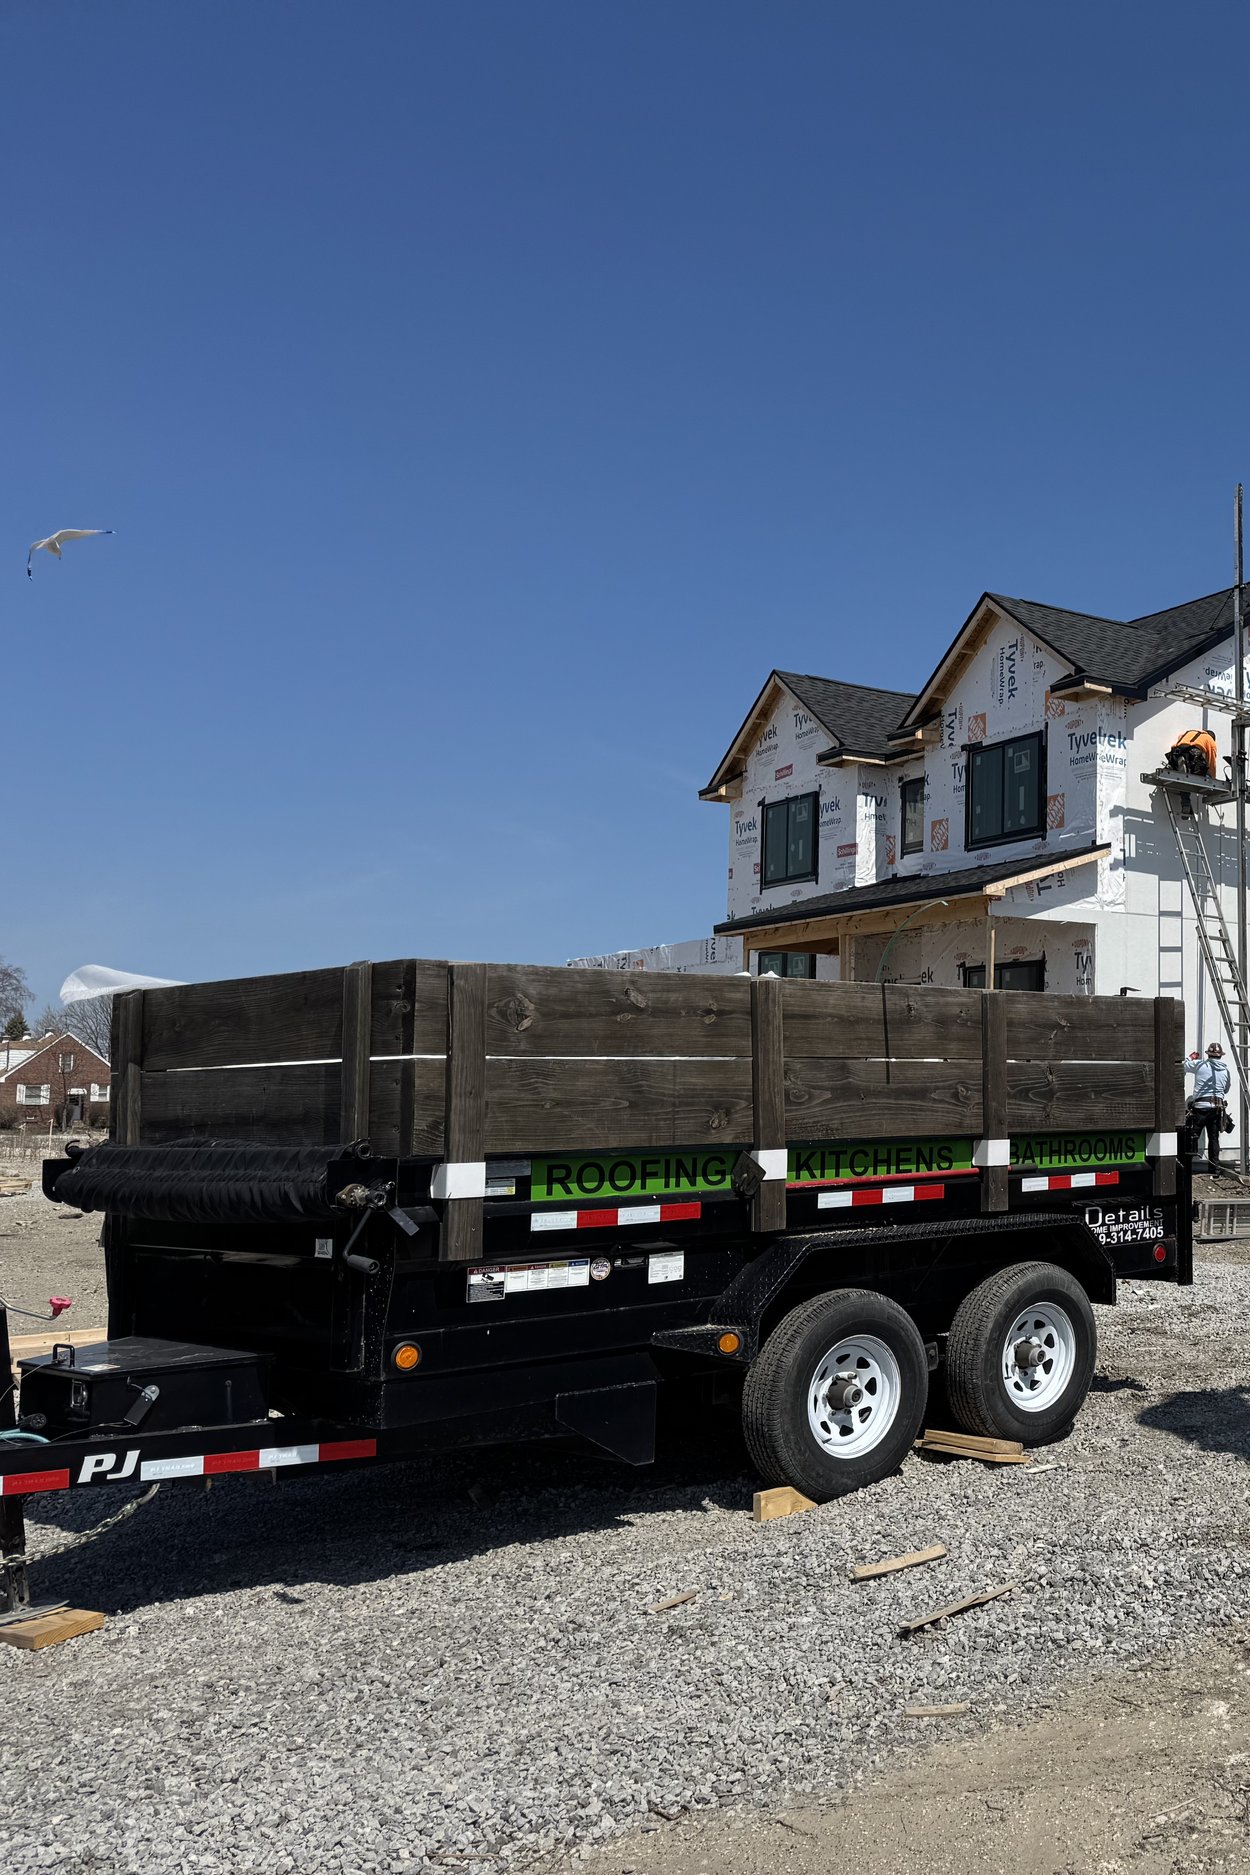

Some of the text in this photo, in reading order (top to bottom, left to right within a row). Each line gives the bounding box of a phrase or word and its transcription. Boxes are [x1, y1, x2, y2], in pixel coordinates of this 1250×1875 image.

[1005, 639, 1018, 700] Tyvek
[758, 724, 778, 747] yvek
[820, 796, 841, 817] yvek
[735, 817, 757, 837] Tyvek
[819, 817, 842, 828] omeWrap
[545, 1155, 727, 1197] ROOFING
[794, 1145, 954, 1180] KITCHENS
[1010, 1136, 1136, 1165] BATHROOMS
[1085, 1205, 1164, 1228] Details
[1109, 1219, 1164, 1233] IMPROVEMENT
[1097, 1226, 1164, 1245] 9-314-7405
[478, 1266, 500, 1274] DANGER
[77, 1450, 141, 1484] PJ
